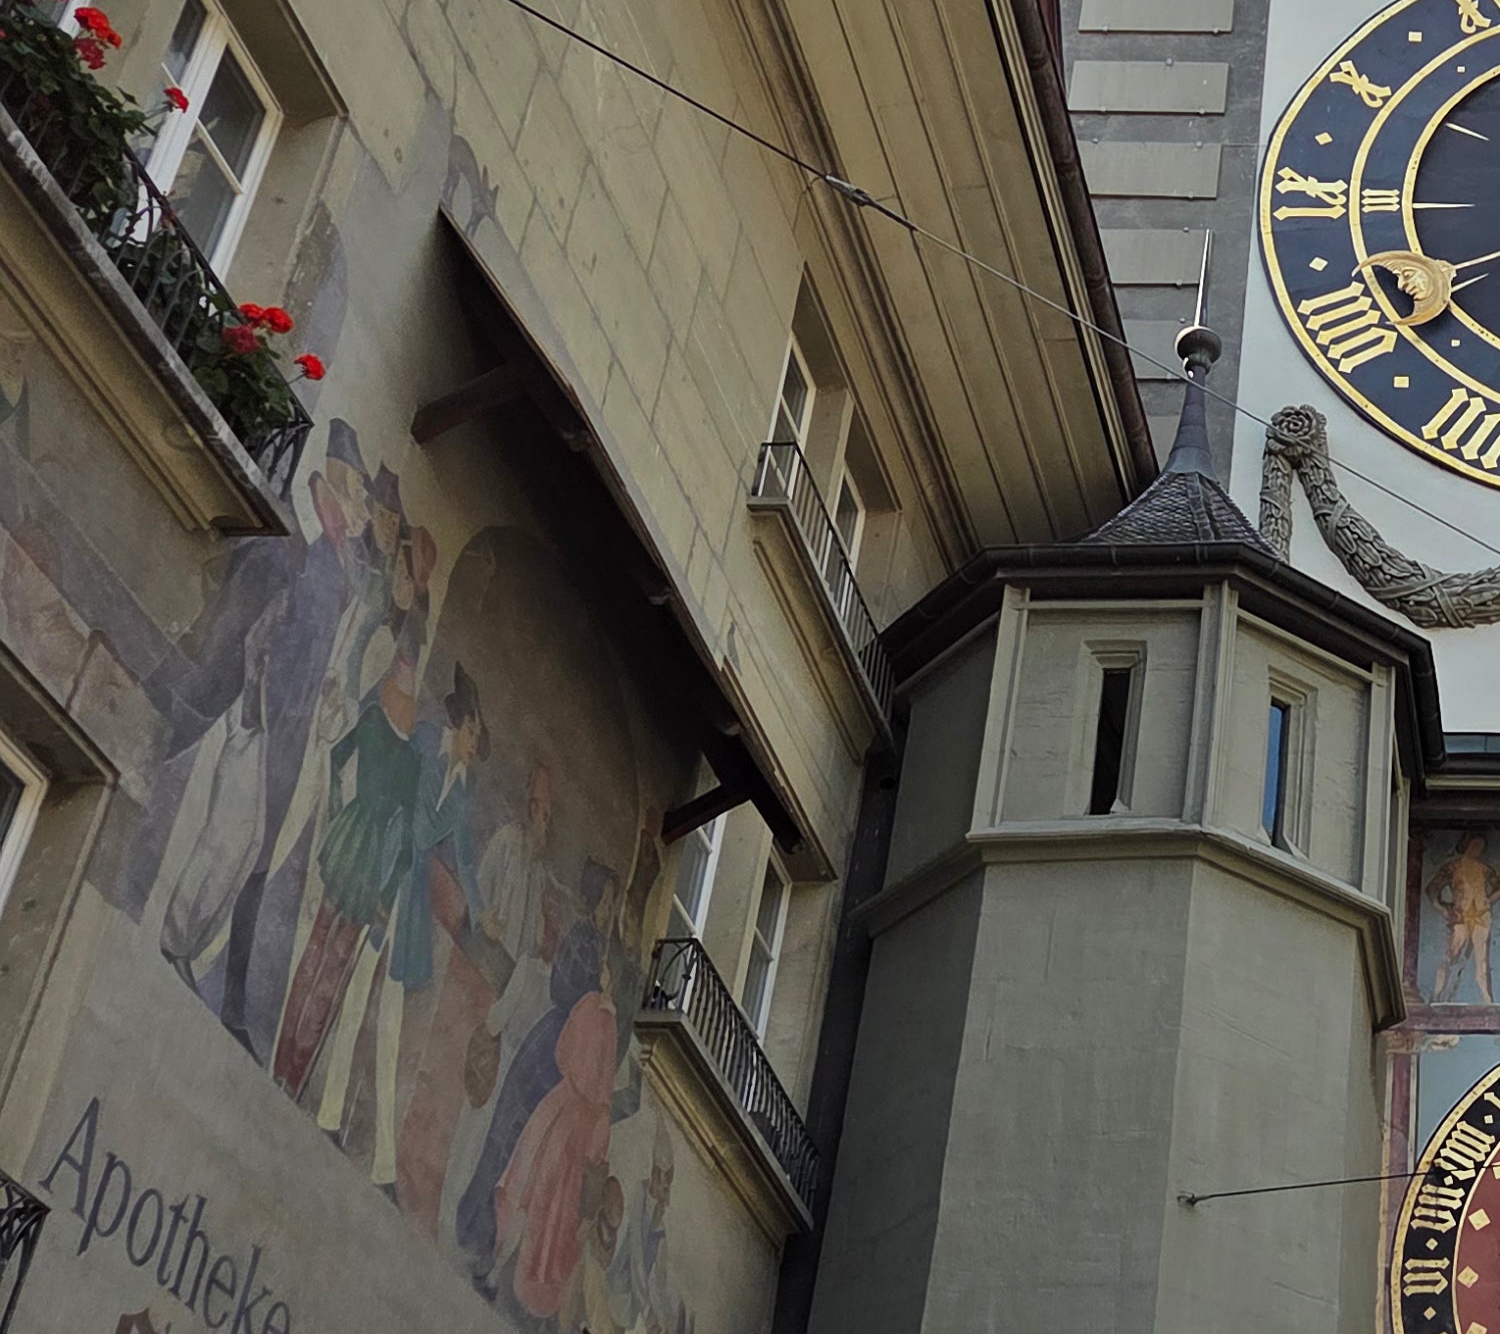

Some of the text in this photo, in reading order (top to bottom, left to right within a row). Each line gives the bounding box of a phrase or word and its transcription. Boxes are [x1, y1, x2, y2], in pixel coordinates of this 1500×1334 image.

[1329, 60, 1392, 108] X
[1272, 166, 1349, 221] IX
[1360, 189, 1400, 213] III
[1297, 280, 1398, 374] VIII
